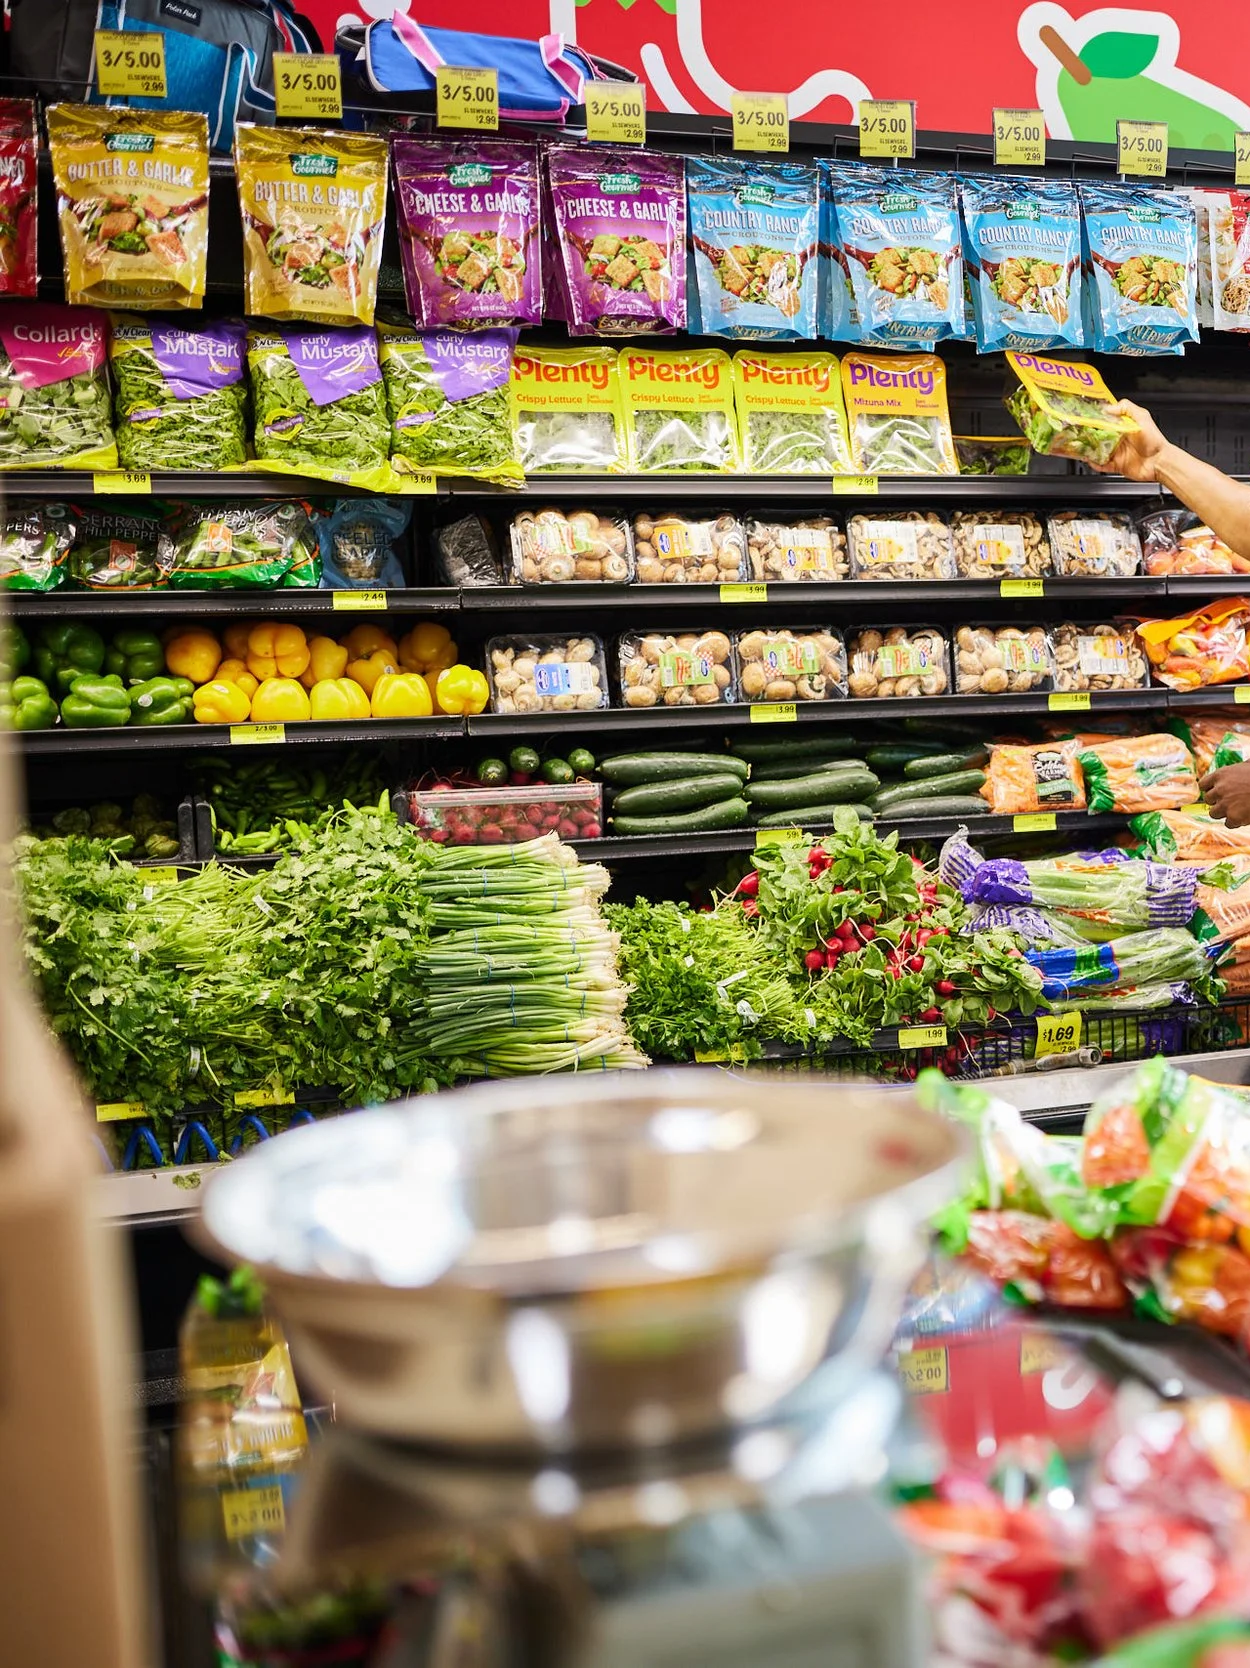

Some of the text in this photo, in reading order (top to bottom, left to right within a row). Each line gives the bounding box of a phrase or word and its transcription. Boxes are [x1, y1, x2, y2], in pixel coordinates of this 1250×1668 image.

[102, 50, 161, 69] 3/5.00
[282, 73, 337, 91] 3/5.00
[442, 84, 495, 103] 3/5.00
[591, 101, 641, 117] 3/5.00
[737, 110, 785, 127] 3/5.00
[861, 117, 907, 133] 3/5.00
[997, 126, 1040, 141] 3/5.00
[1122, 136, 1162, 152] 3/5.00
[67, 158, 194, 188] BUTTER & GARLIC
[292, 161, 337, 176] Gourmet
[457, 165, 483, 177] Fresh
[450, 173, 491, 185] Gourmet
[600, 181, 640, 192] Gourmet
[255, 181, 308, 203] BUTTER
[312, 184, 324, 204] &
[415, 193, 530, 215] CHEESE & GARLIC
[567, 200, 618, 219] CHEESE
[620, 200, 631, 219] &
[1012, 202, 1035, 212] Fresh
[704, 210, 762, 231] COUNTRY
[1006, 209, 1039, 219] Gourmet
[978, 226, 1072, 246] COUNTRY RANCH
[1101, 226, 1153, 244] COUNTRY
[302, 342, 378, 360] Mustard
[437, 341, 510, 359] Mustard
[514, 356, 609, 390] Plenty
[628, 356, 720, 390] Plenty
[742, 359, 830, 392] Plenty
[850, 363, 934, 395] Plenty
[1014, 354, 1094, 386] Plenty
[516, 393, 582, 405] Crispy Lettuce
[631, 393, 694, 405] Crispy Lettuce
[745, 395, 806, 406] Crispy Lettuce
[854, 397, 902, 407] Mizuna Mix
[80, 513, 170, 532] SERRANO
[118, 528, 160, 542] PEPPE
[1043, 1026, 1074, 1043] $1.69
